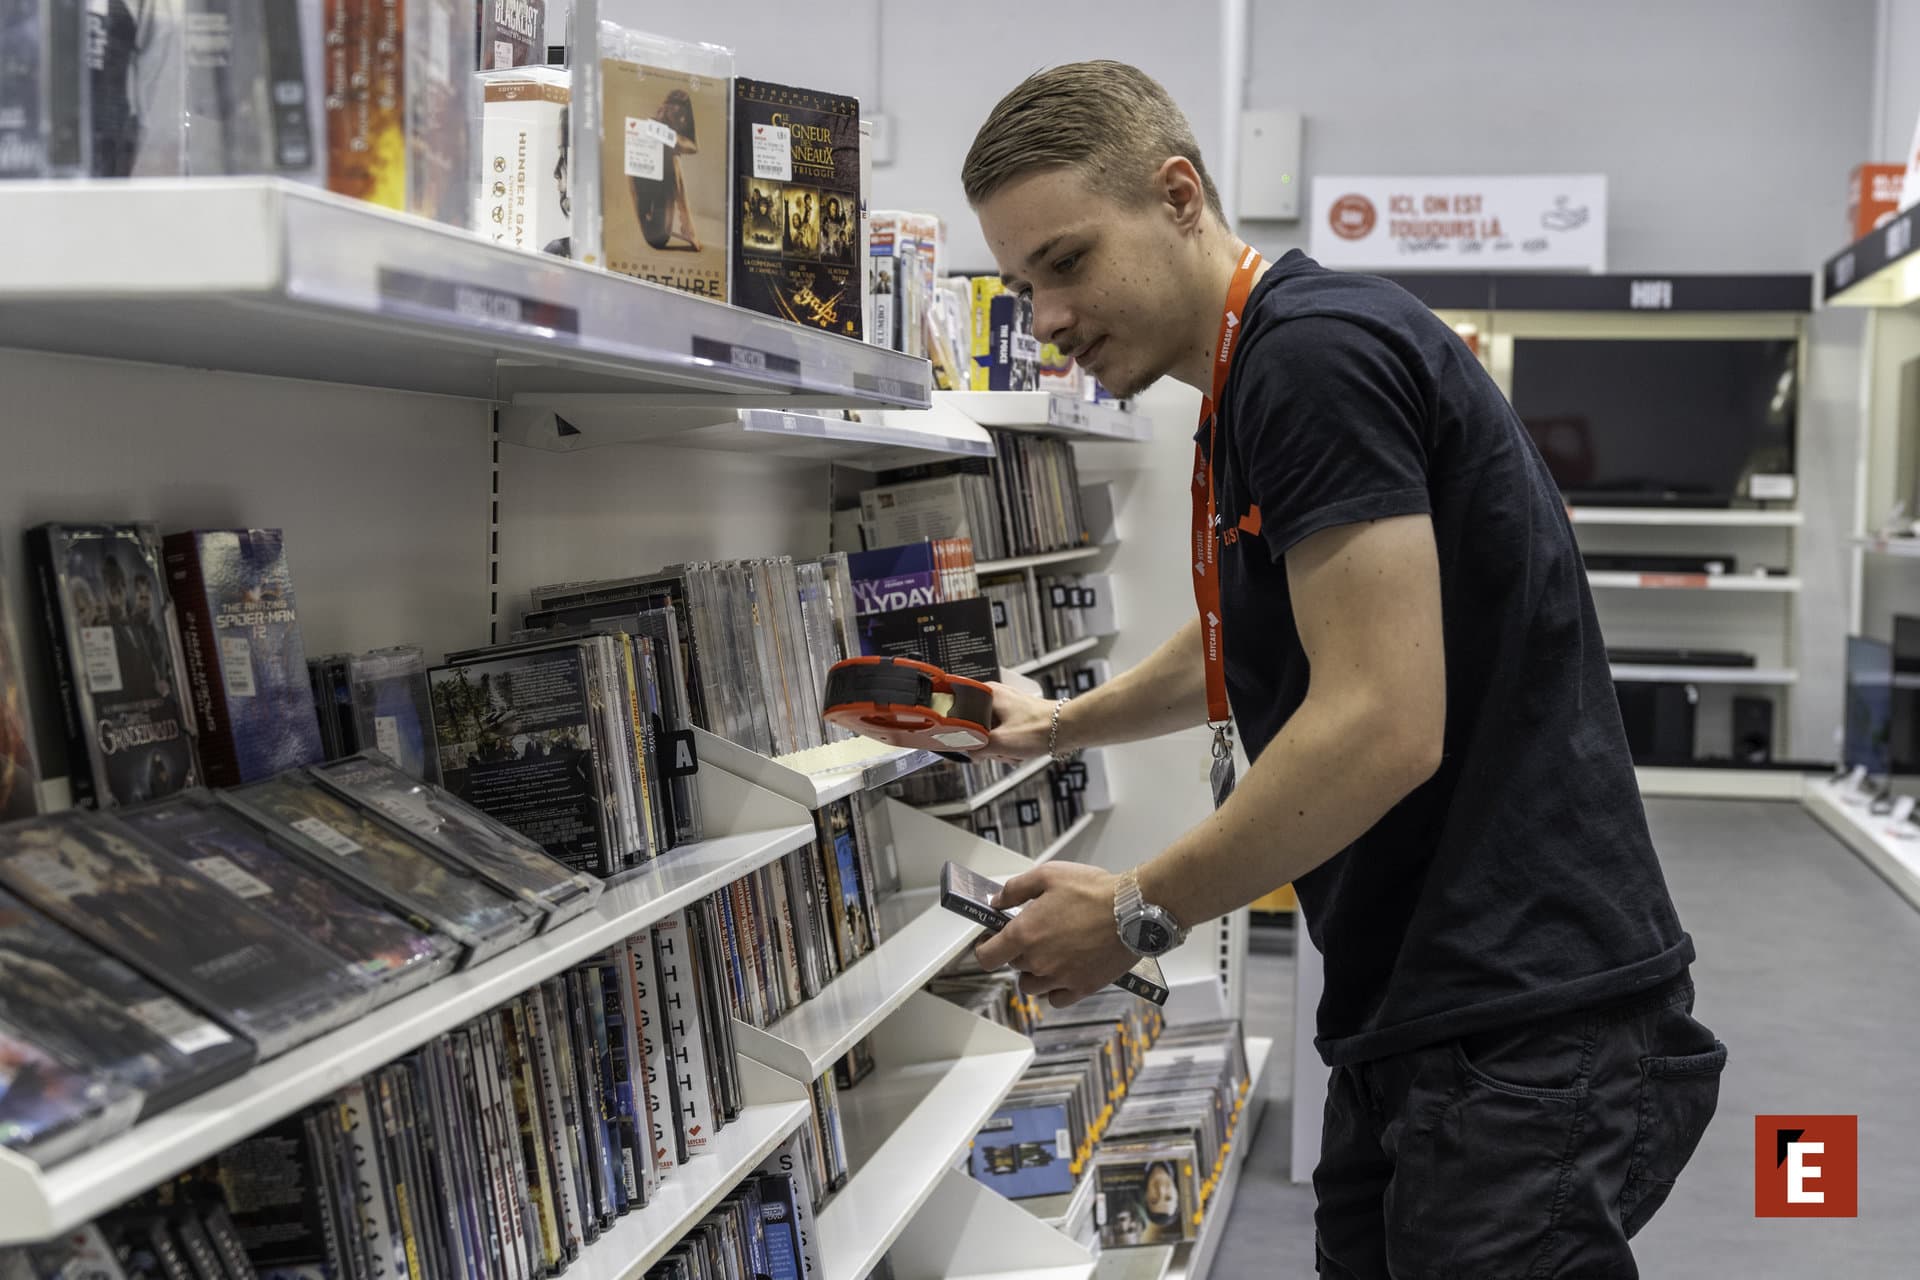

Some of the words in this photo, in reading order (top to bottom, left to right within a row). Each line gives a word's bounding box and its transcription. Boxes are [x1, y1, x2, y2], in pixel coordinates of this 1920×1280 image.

[791, 144, 834, 165] NNEAUX
[516, 132, 527, 206] HUNGER
[1454, 195, 1483, 213] EST
[1388, 219, 1476, 238] TOUJOURS
[1000, 325, 1008, 340] THE
[1000, 343, 1008, 364] POLICE
[856, 586, 935, 616] LYDAY
[216, 610, 296, 629] SPIDER-MAN
[675, 739, 694, 769] A
[779, 1154, 793, 1170] S
